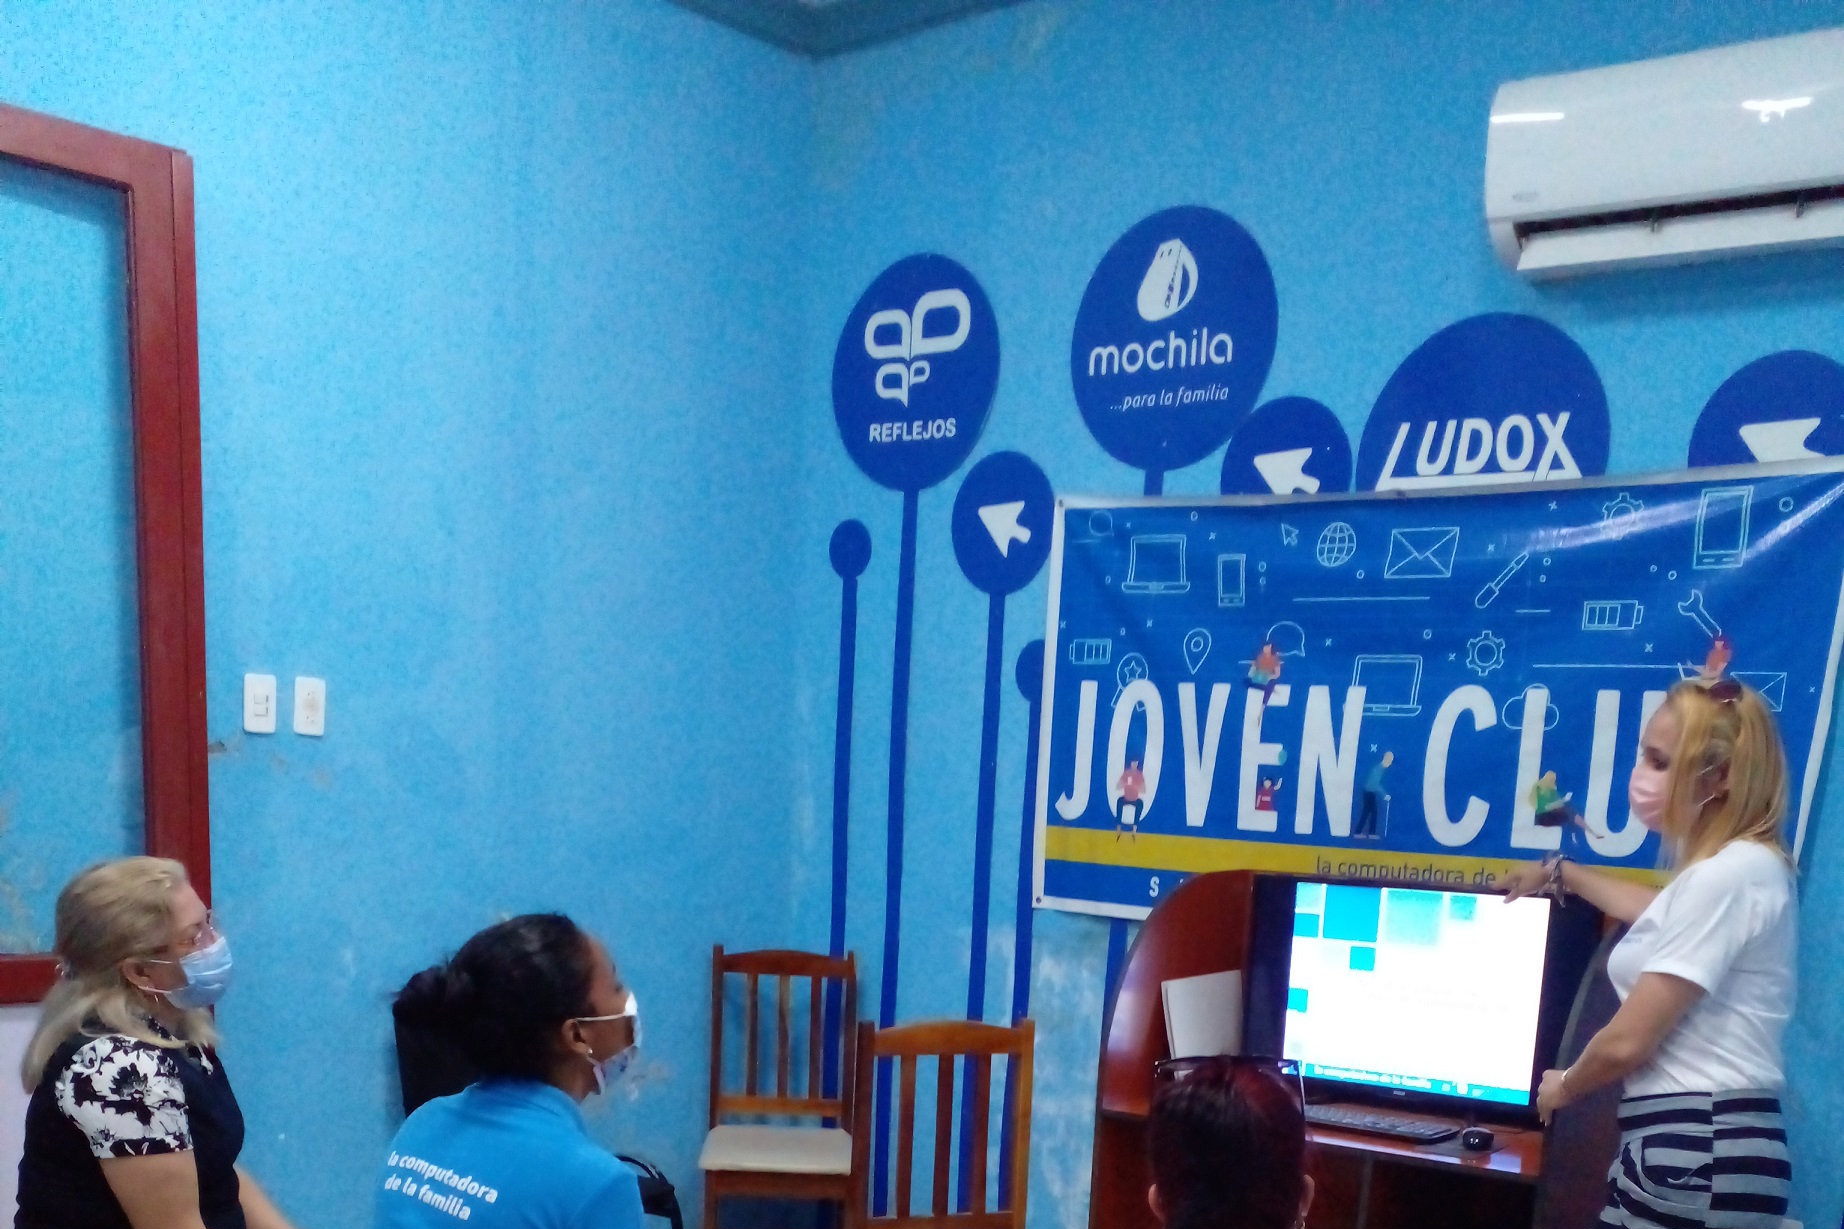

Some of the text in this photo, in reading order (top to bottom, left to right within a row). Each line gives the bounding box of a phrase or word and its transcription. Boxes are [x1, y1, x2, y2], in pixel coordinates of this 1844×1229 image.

[1088, 327, 1233, 376] mochila
[1158, 387, 1172, 407] la
[1174, 384, 1230, 406] familia
[868, 417, 957, 443] REFLEJOS
[1372, 411, 1583, 491] LUDOX
[1055, 680, 1668, 857] JOVEN CLU
[1317, 855, 1331, 875] la
[1337, 862, 1465, 885] computadora
[1472, 867, 1496, 885] de
[384, 1174, 471, 1221] de la familia
[387, 1150, 498, 1204] la computadora
